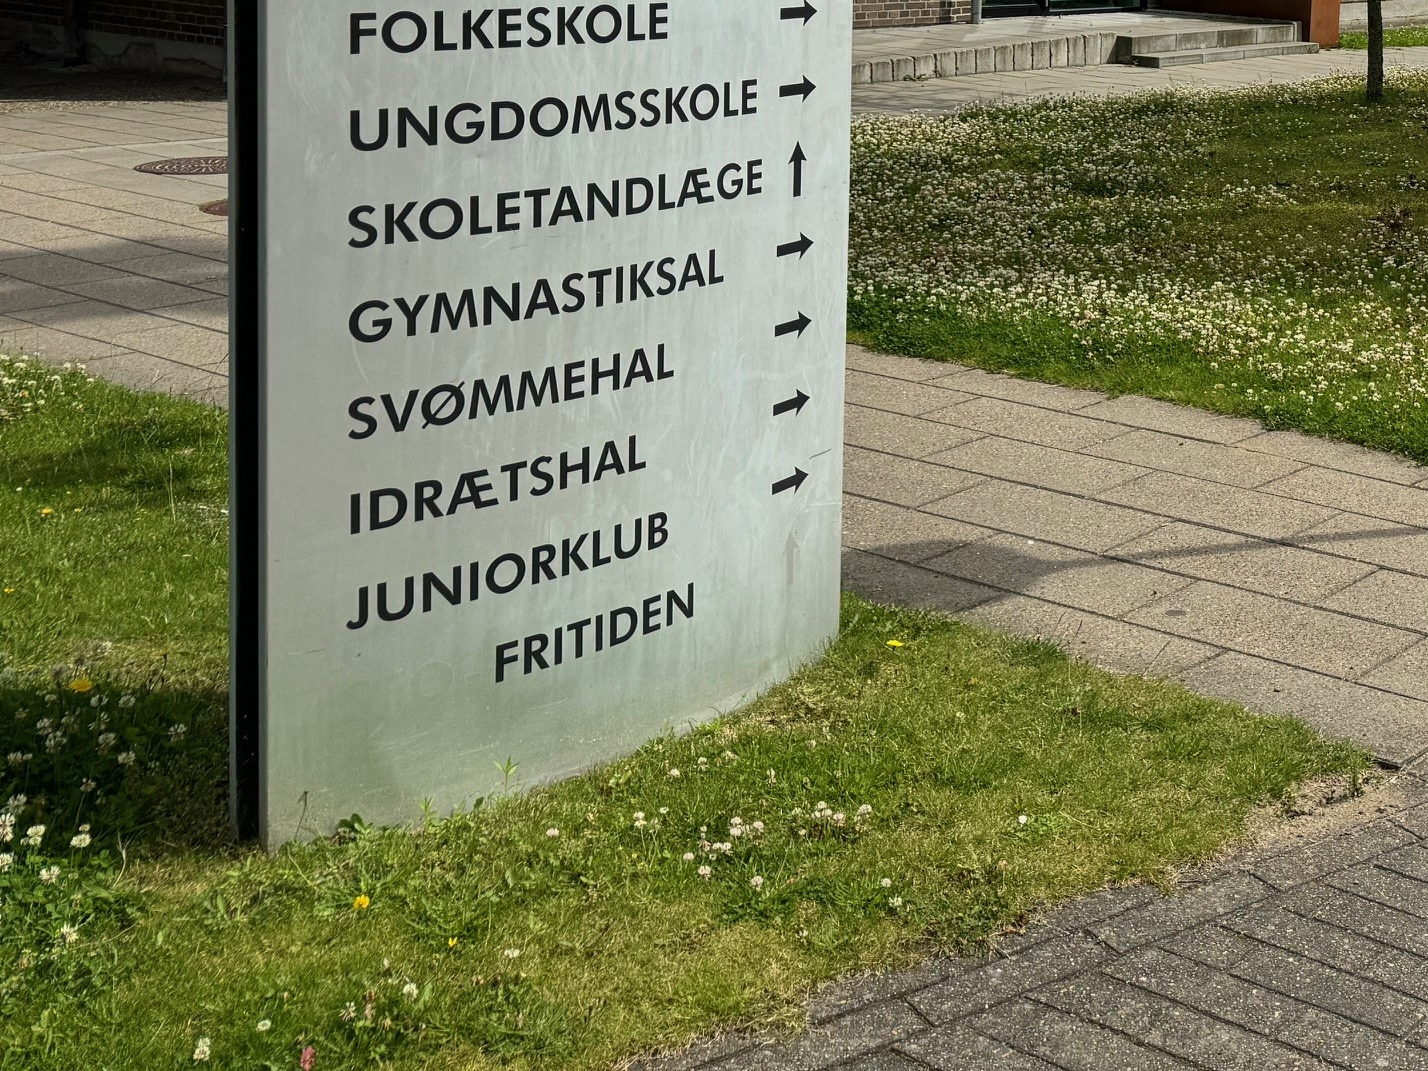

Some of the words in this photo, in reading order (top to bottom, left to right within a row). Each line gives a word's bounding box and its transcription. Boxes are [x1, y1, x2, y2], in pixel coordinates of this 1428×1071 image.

[350, 3, 667, 54] FOLKESKOLE
[350, 79, 757, 151] UNGDOMSSKOLE
[348, 159, 762, 248] SKOLETANDLÆGE
[349, 249, 723, 343] GYMNASTIKSAL
[349, 344, 674, 439] SVØMMEHAL
[351, 435, 646, 534] IDRÆTSHAL
[346, 512, 668, 630] JUNIORKLUB
[496, 583, 696, 683] FRITIDEN
